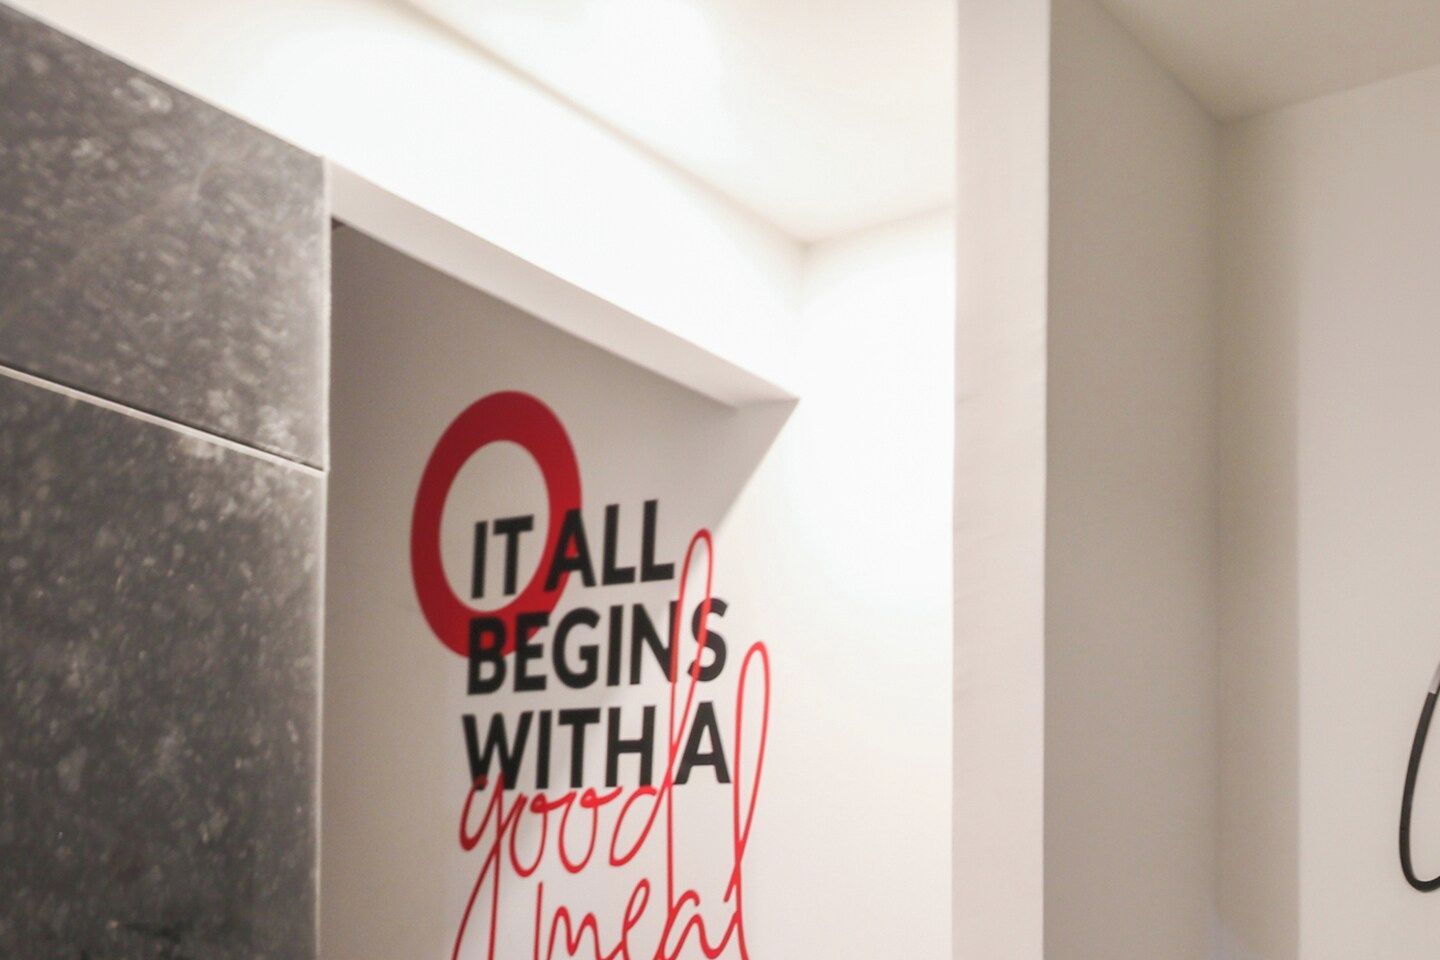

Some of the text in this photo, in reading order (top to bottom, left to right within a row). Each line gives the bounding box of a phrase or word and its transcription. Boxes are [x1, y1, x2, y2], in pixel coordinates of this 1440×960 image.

[470, 499, 675, 599] IT ALL
[466, 597, 729, 695] BEGINS
[461, 701, 732, 791] WITH A
